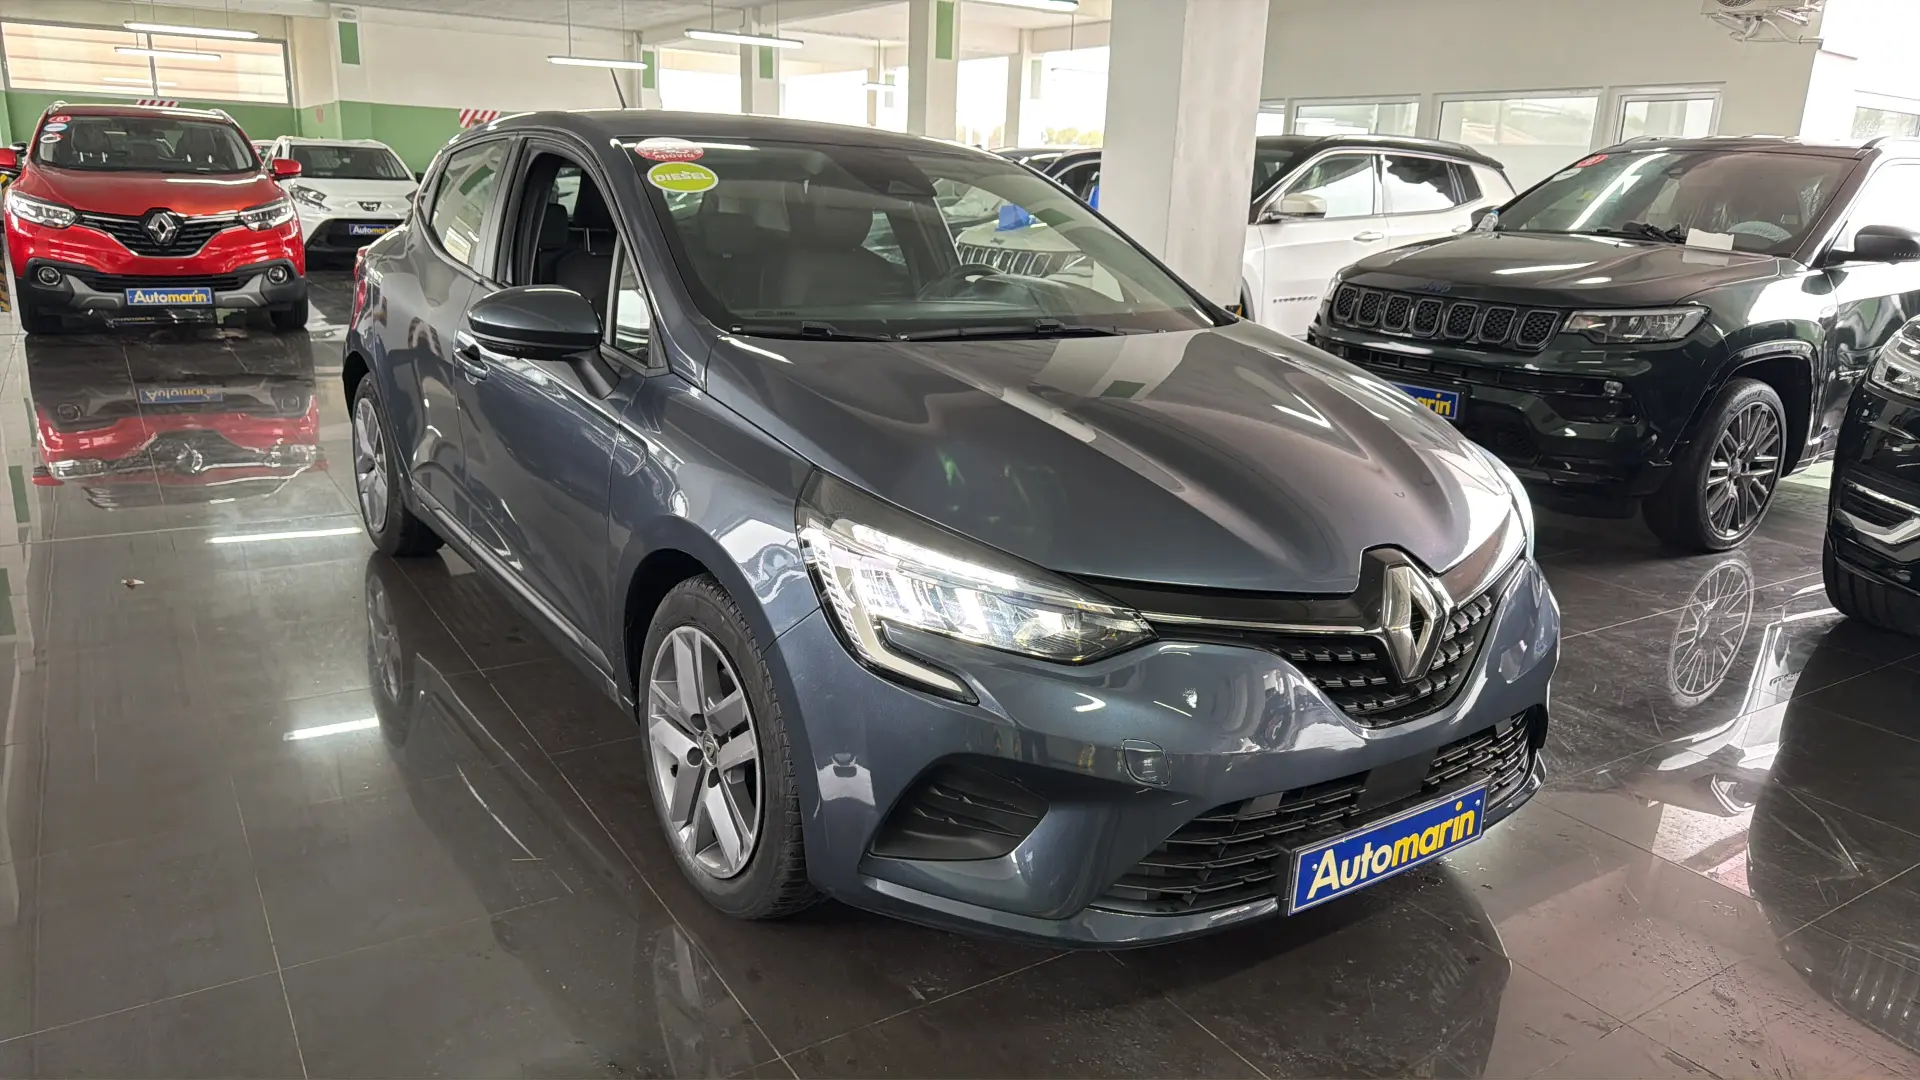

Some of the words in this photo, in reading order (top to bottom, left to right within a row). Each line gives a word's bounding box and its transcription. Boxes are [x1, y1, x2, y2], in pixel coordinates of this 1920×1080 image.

[654, 171, 712, 182] DIESEL
[134, 289, 207, 303] Automarin
[1306, 800, 1475, 900] Automarin
